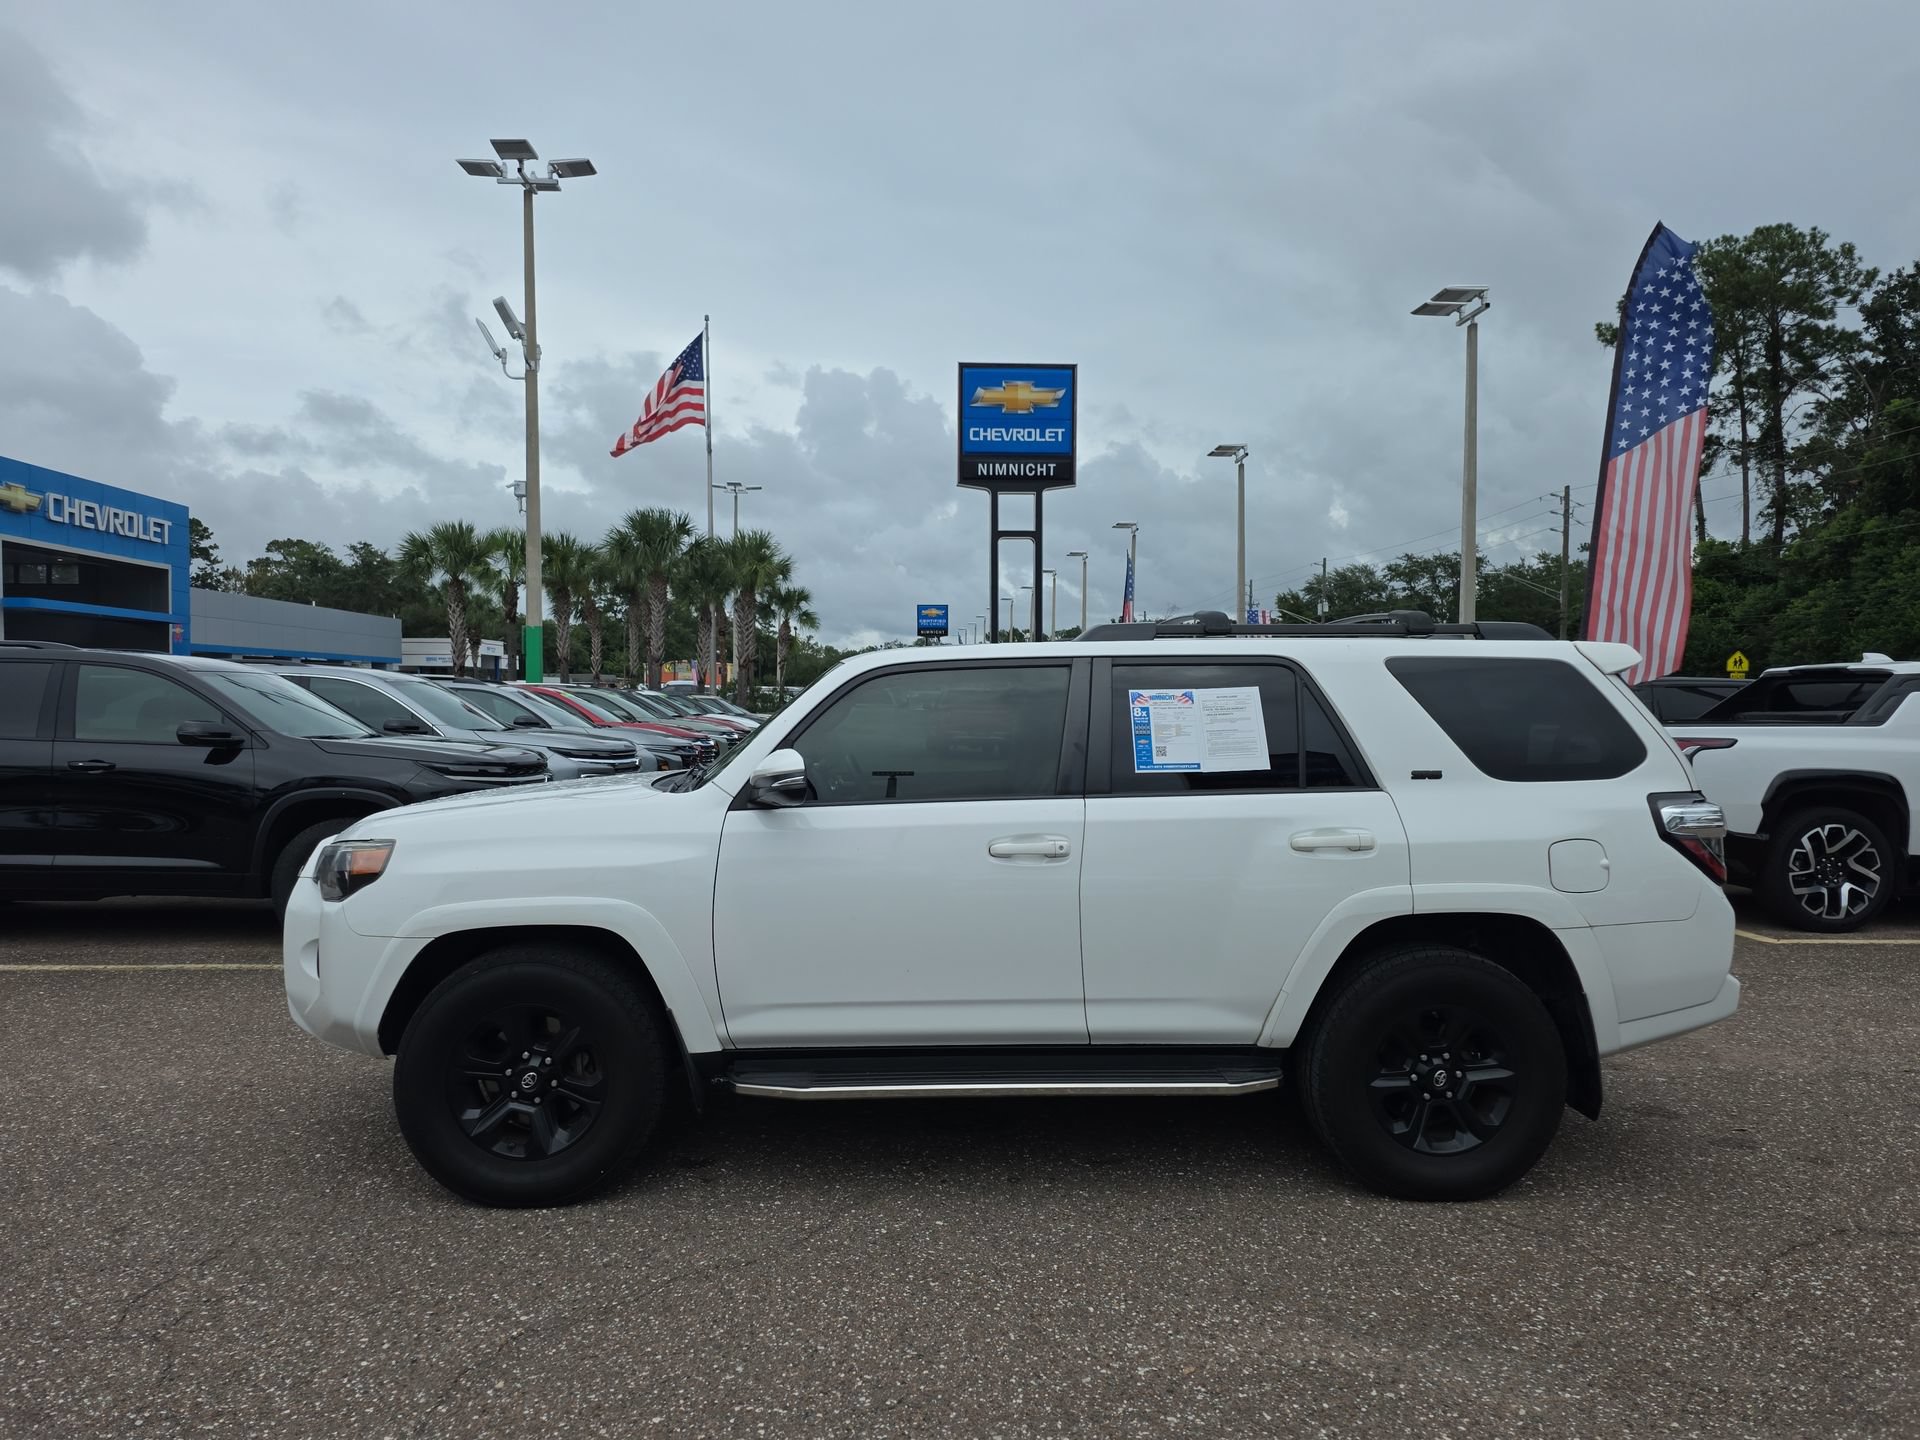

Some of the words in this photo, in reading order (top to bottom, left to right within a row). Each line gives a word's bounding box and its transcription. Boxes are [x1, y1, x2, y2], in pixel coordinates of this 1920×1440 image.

[969, 427, 1065, 442] CHEVROLET
[977, 463, 1056, 476] NIMNICHT
[45, 492, 172, 545] CHEVROLET
